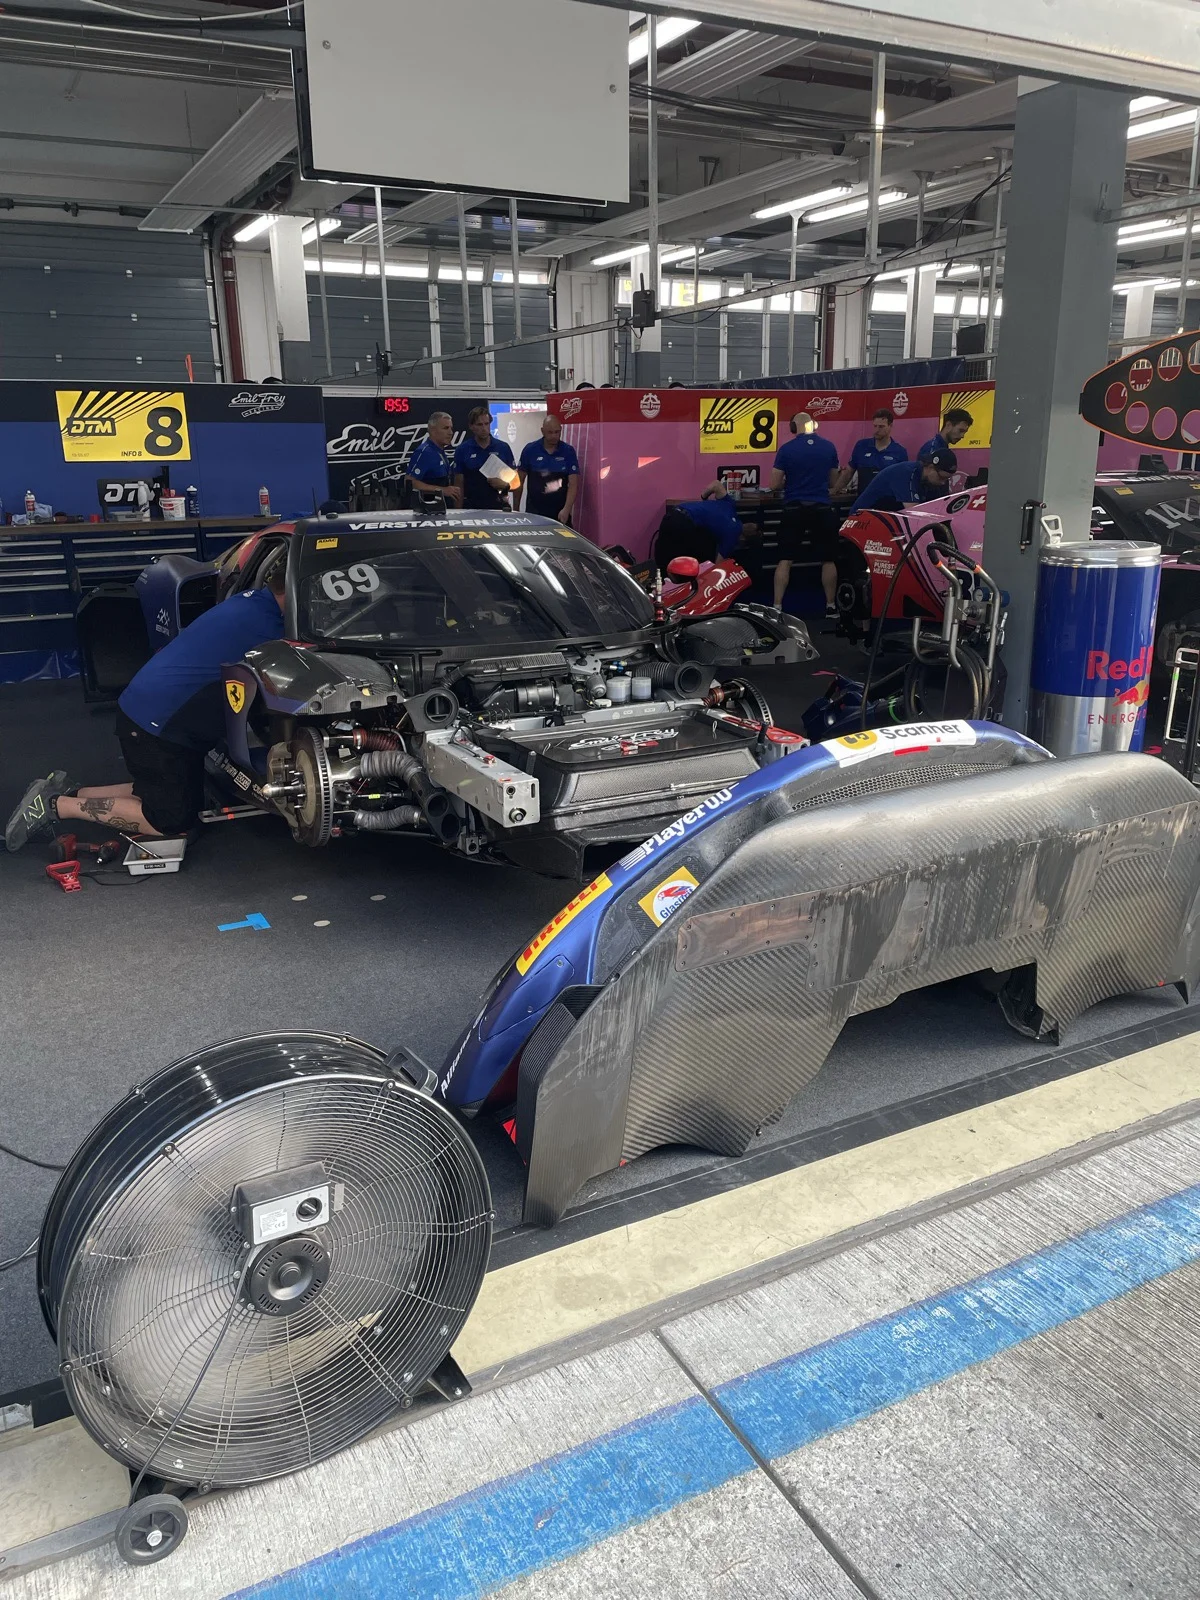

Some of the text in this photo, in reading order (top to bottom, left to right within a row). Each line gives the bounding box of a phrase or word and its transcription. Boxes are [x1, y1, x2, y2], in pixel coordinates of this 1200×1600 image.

[70, 420, 113, 434] DTM
[144, 406, 183, 457] 8
[705, 420, 732, 432] DTM
[749, 409, 776, 449] 8
[326, 423, 396, 454] Emil
[348, 517, 532, 531] VERSTAPPEN.COM
[1144, 502, 1194, 530] 14
[437, 530, 491, 541] DTM
[493, 529, 555, 538] VERMEULEN
[321, 563, 380, 602] 69
[1087, 710, 1142, 725] ENERGY
[878, 723, 962, 740] Scanner
[522, 881, 599, 962] PIRELLI
